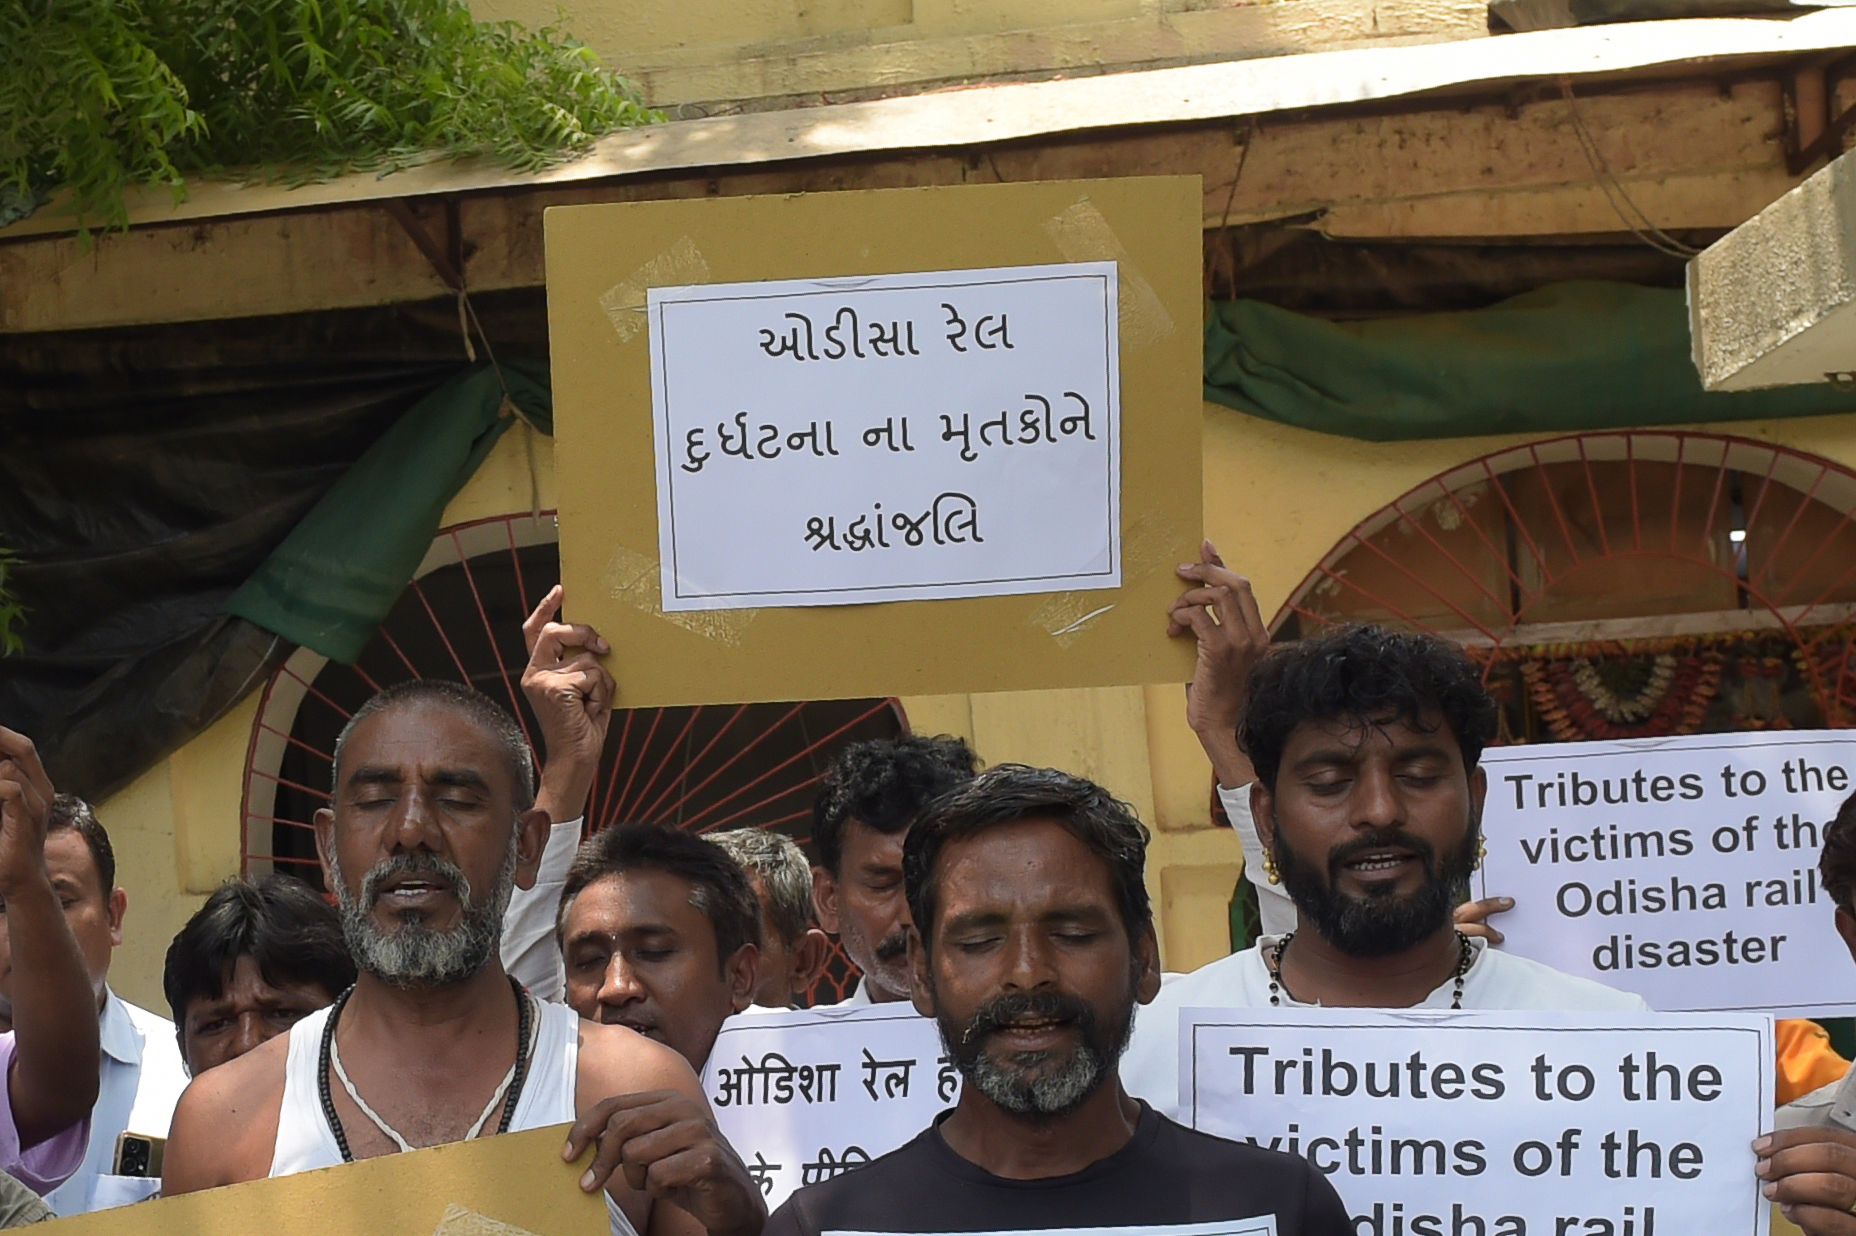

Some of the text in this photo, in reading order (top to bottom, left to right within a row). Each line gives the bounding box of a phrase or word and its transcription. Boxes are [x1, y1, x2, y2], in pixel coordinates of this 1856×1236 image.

[758, 303, 1015, 362] ઓડીસા રેલ
[862, 417, 915, 452] ના
[939, 391, 1096, 462] મૃતકોને
[804, 492, 984, 552] શ્રદ્ધાંજલિ
[1503, 758, 1849, 810] Tributes to the
[1519, 824, 1694, 865] victims
[1712, 815, 1760, 853] of
[1556, 868, 1816, 918] Odisha rail
[1592, 930, 1787, 971] disaster
[713, 1052, 842, 1107] ओडिशा
[861, 1047, 917, 1102] रेल
[1229, 1046, 1723, 1102] Tributes to the
[1513, 1128, 1582, 1177] of
[1600, 1129, 1704, 1180] the
